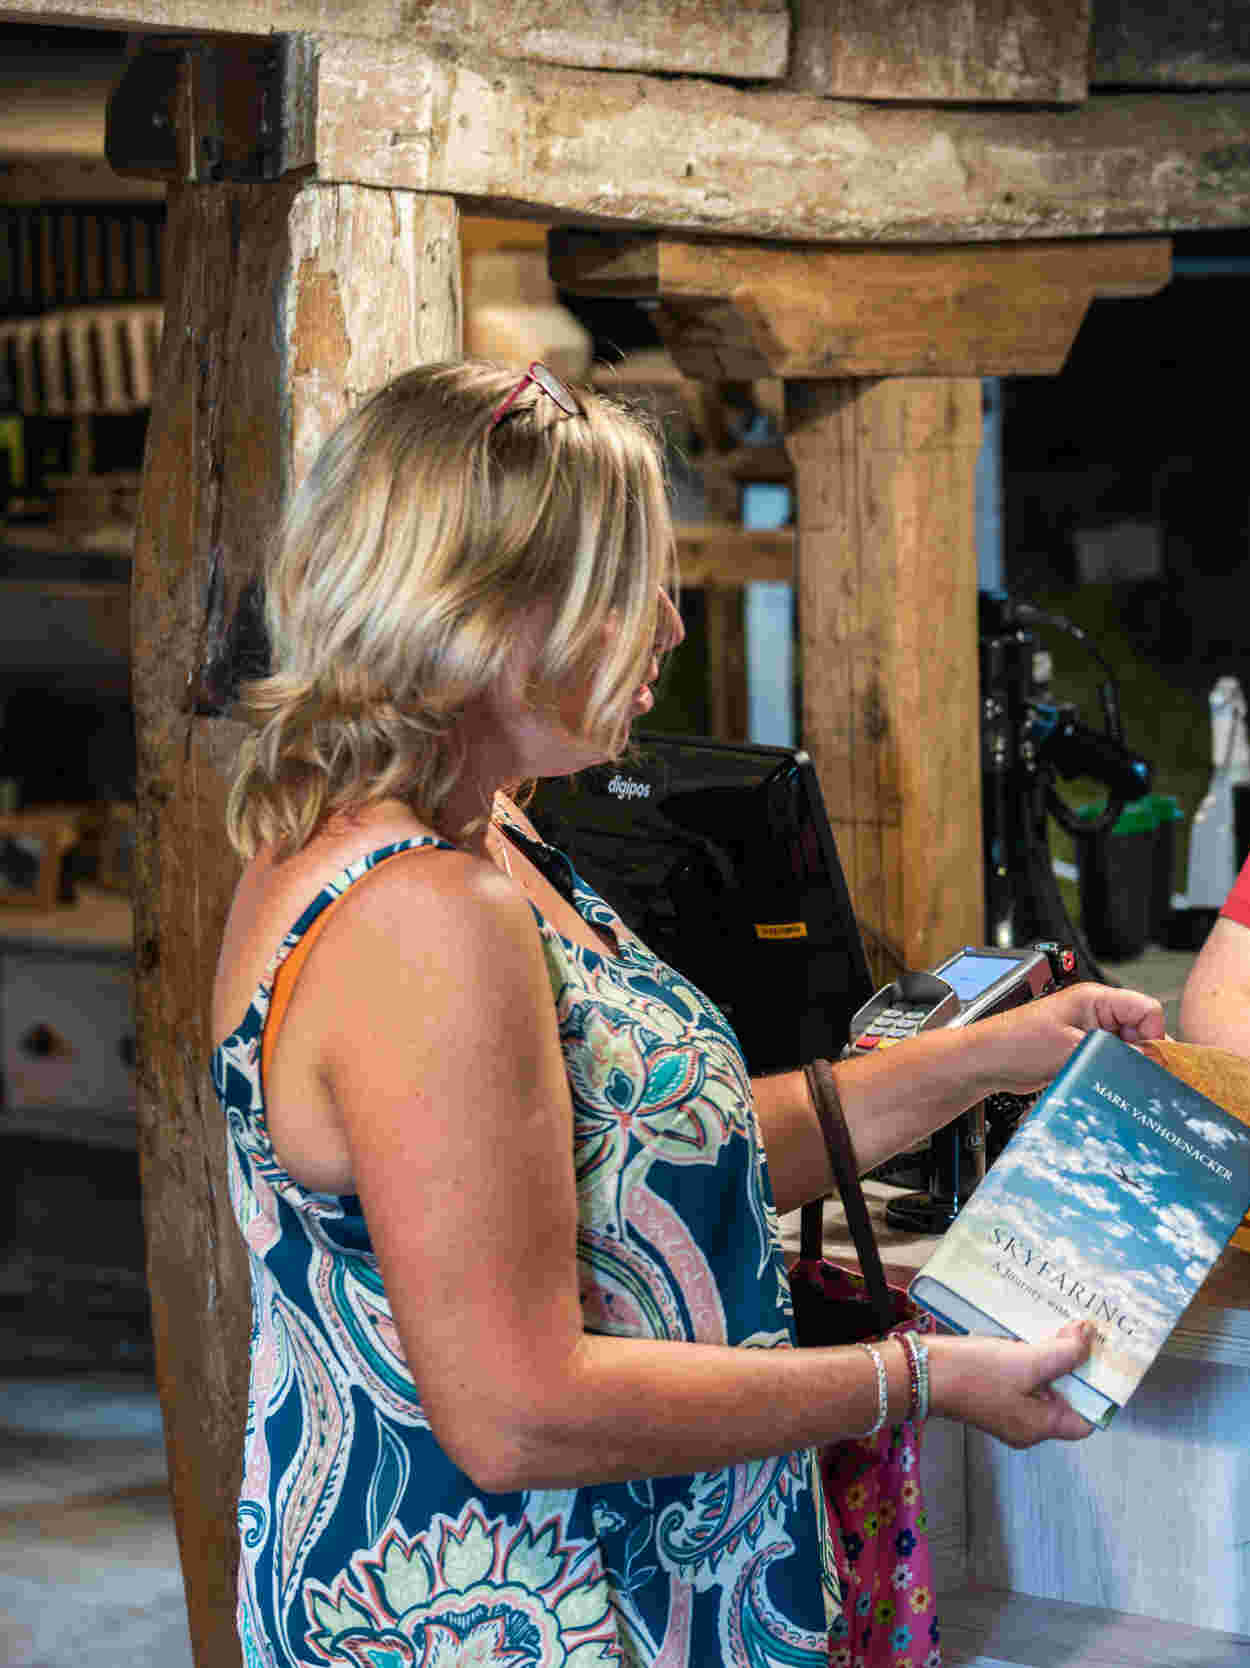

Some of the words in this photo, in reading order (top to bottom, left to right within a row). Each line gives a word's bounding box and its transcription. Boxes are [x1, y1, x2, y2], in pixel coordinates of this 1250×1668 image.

[608, 775, 650, 800] digipos
[1093, 1079, 1130, 1112] MARK
[1132, 1106, 1234, 1184] VANHOENACKER
[993, 1228, 1136, 1337] SKYFARING
